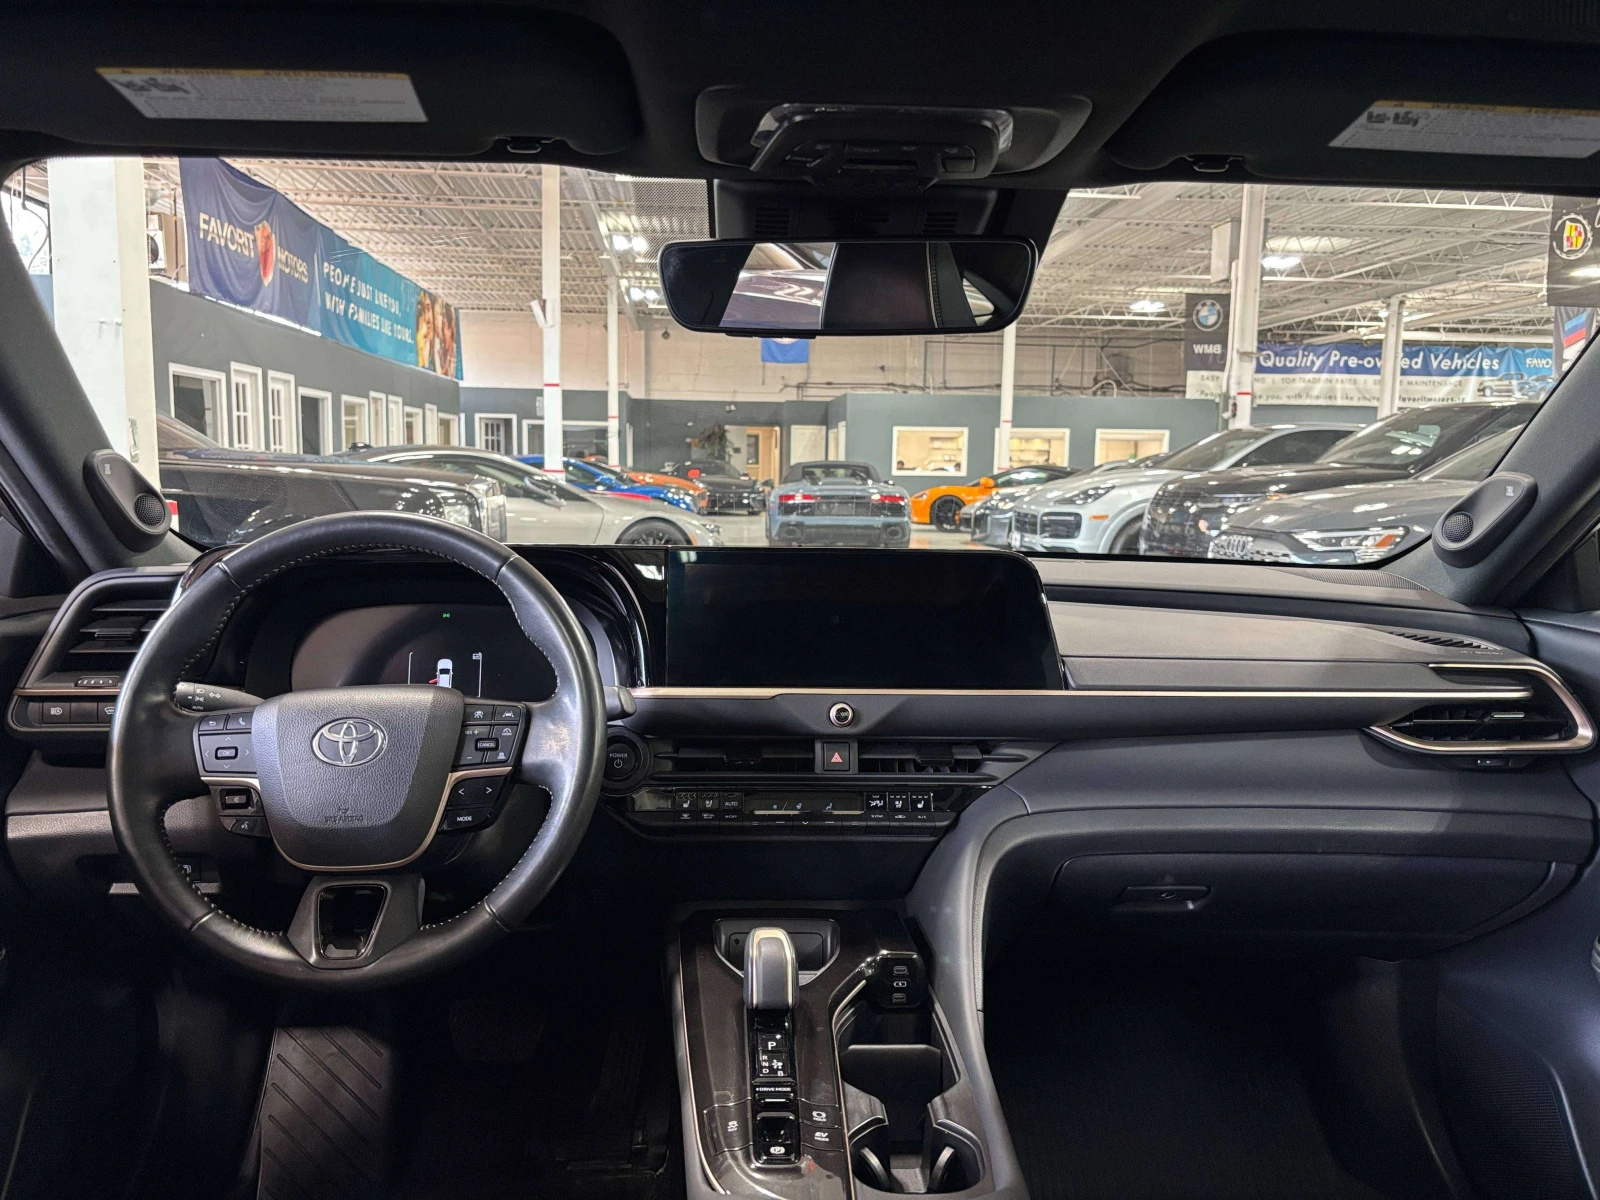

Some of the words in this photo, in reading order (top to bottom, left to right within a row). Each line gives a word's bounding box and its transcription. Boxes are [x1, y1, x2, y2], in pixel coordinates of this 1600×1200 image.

[199, 212, 255, 259] FAVORIT
[1259, 350, 1325, 372] Quality
[1329, 351, 1424, 369] Pre-oed
[1430, 351, 1500, 370] Vehicles
[767, 1041, 777, 1051] P
